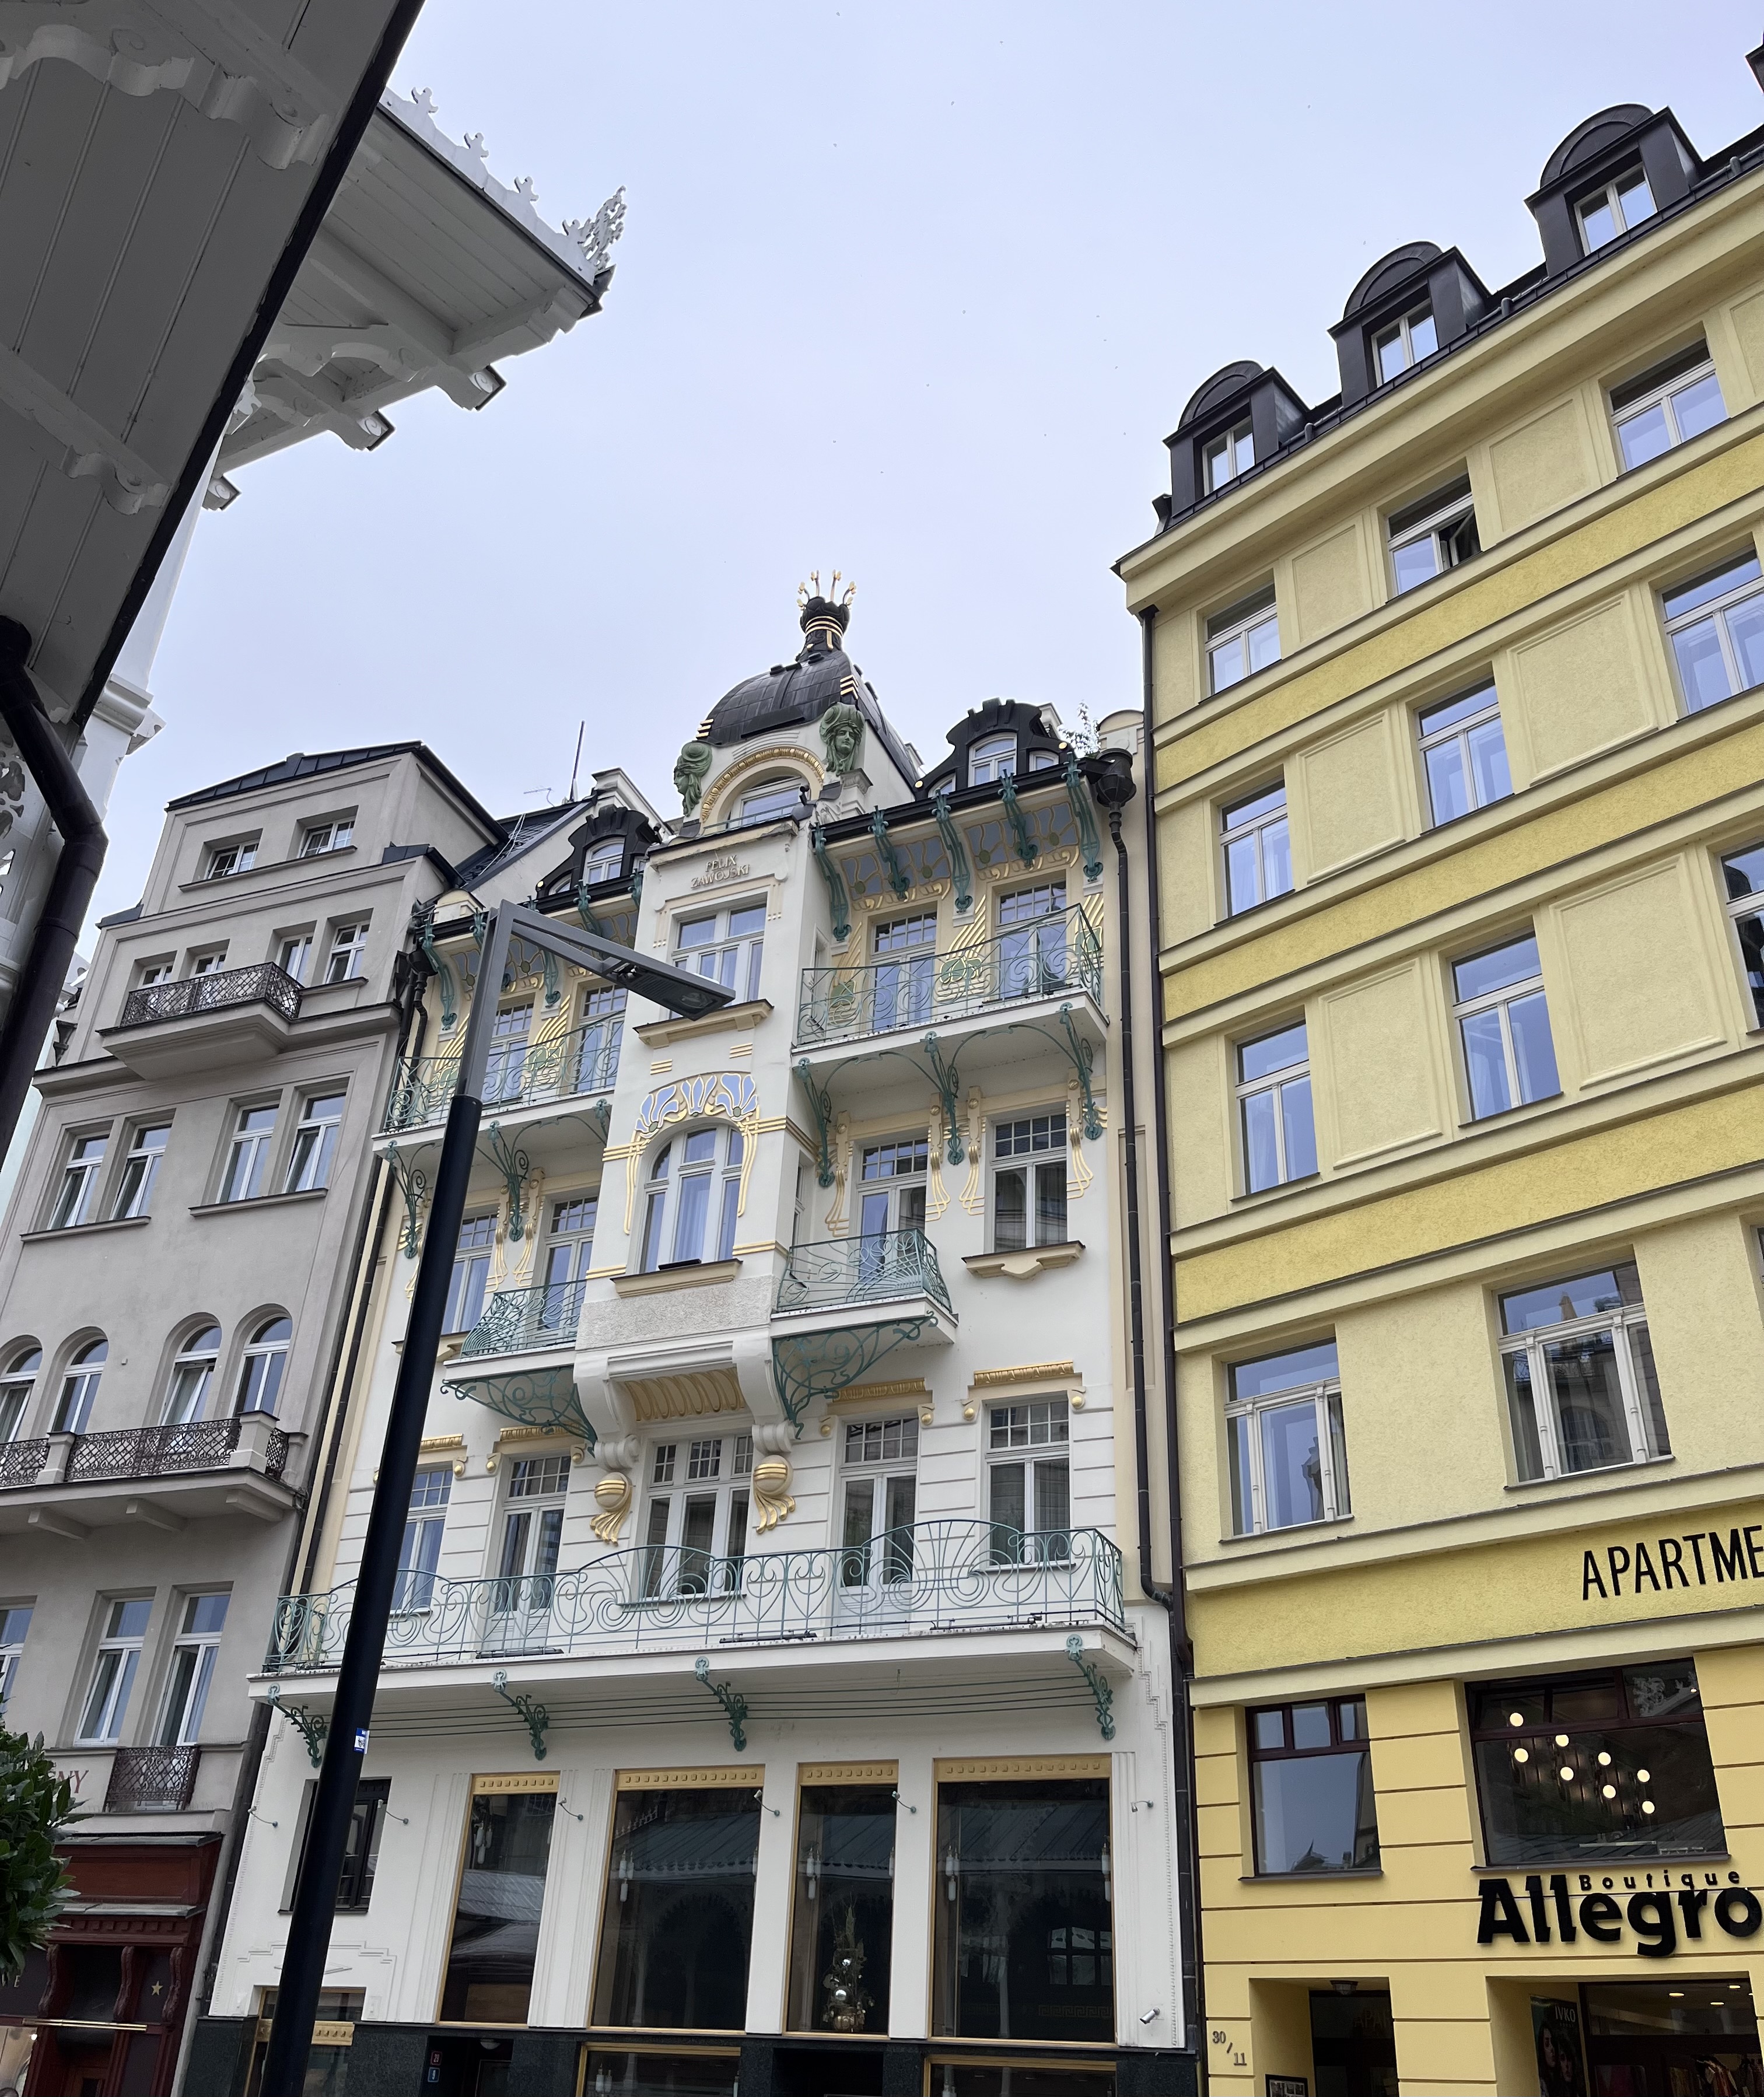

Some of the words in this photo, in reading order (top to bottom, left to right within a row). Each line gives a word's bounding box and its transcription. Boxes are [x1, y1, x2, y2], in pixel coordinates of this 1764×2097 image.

[705, 855, 737, 872] FELIX
[691, 864, 750, 889] ZAWOJSKI
[1583, 1525, 1764, 1601] APARTME
[1578, 1870, 1740, 1891] Boutique
[1477, 1874, 1763, 1956] Allegro
[1555, 2005, 1576, 2022] IVKO
